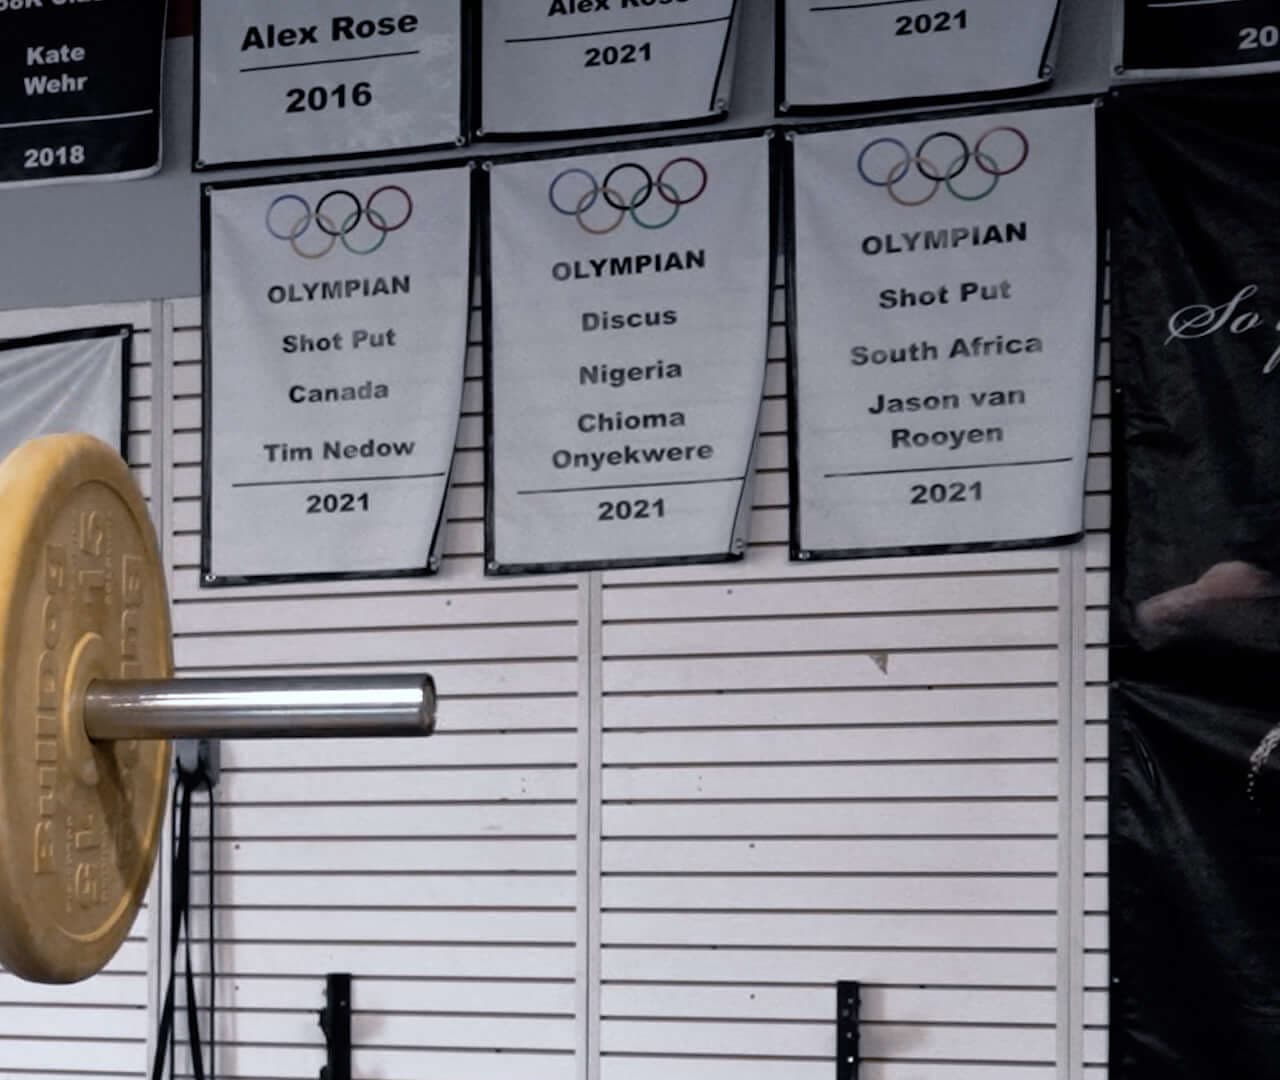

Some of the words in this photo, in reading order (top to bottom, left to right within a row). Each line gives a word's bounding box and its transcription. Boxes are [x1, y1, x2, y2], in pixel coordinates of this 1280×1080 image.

[548, 0, 609, 16] Alex
[241, 24, 317, 51] Alex
[332, 15, 418, 41] Rose
[896, 10, 966, 36] 2021
[27, 45, 85, 65] Kate
[585, 43, 650, 67] 2021
[24, 74, 87, 95] Wehr
[286, 82, 372, 113] 2016
[24, 145, 84, 168] 2018
[862, 222, 1026, 255] OLYMPIAN
[553, 250, 704, 280] OLYMPIAN
[268, 275, 410, 303] OLYMPIAN
[880, 287, 948, 309] Shot
[961, 282, 1009, 302] Put
[582, 310, 677, 331] Discus
[283, 334, 341, 353] Shot
[353, 329, 395, 348] Put
[852, 341, 938, 366] South
[949, 336, 1041, 358] Africa
[580, 360, 682, 387] Nigeria
[289, 382, 388, 403] Canada
[869, 395, 959, 414] Jason
[971, 391, 1024, 406] van
[578, 412, 685, 432] Chioma
[264, 444, 312, 462] Tim
[323, 439, 414, 459] Nedow
[892, 428, 1002, 450] Rooyen
[552, 445, 712, 471] Onyekwere
[307, 493, 368, 513] 2021
[911, 482, 981, 504] 2021
[599, 498, 664, 520] 2021
